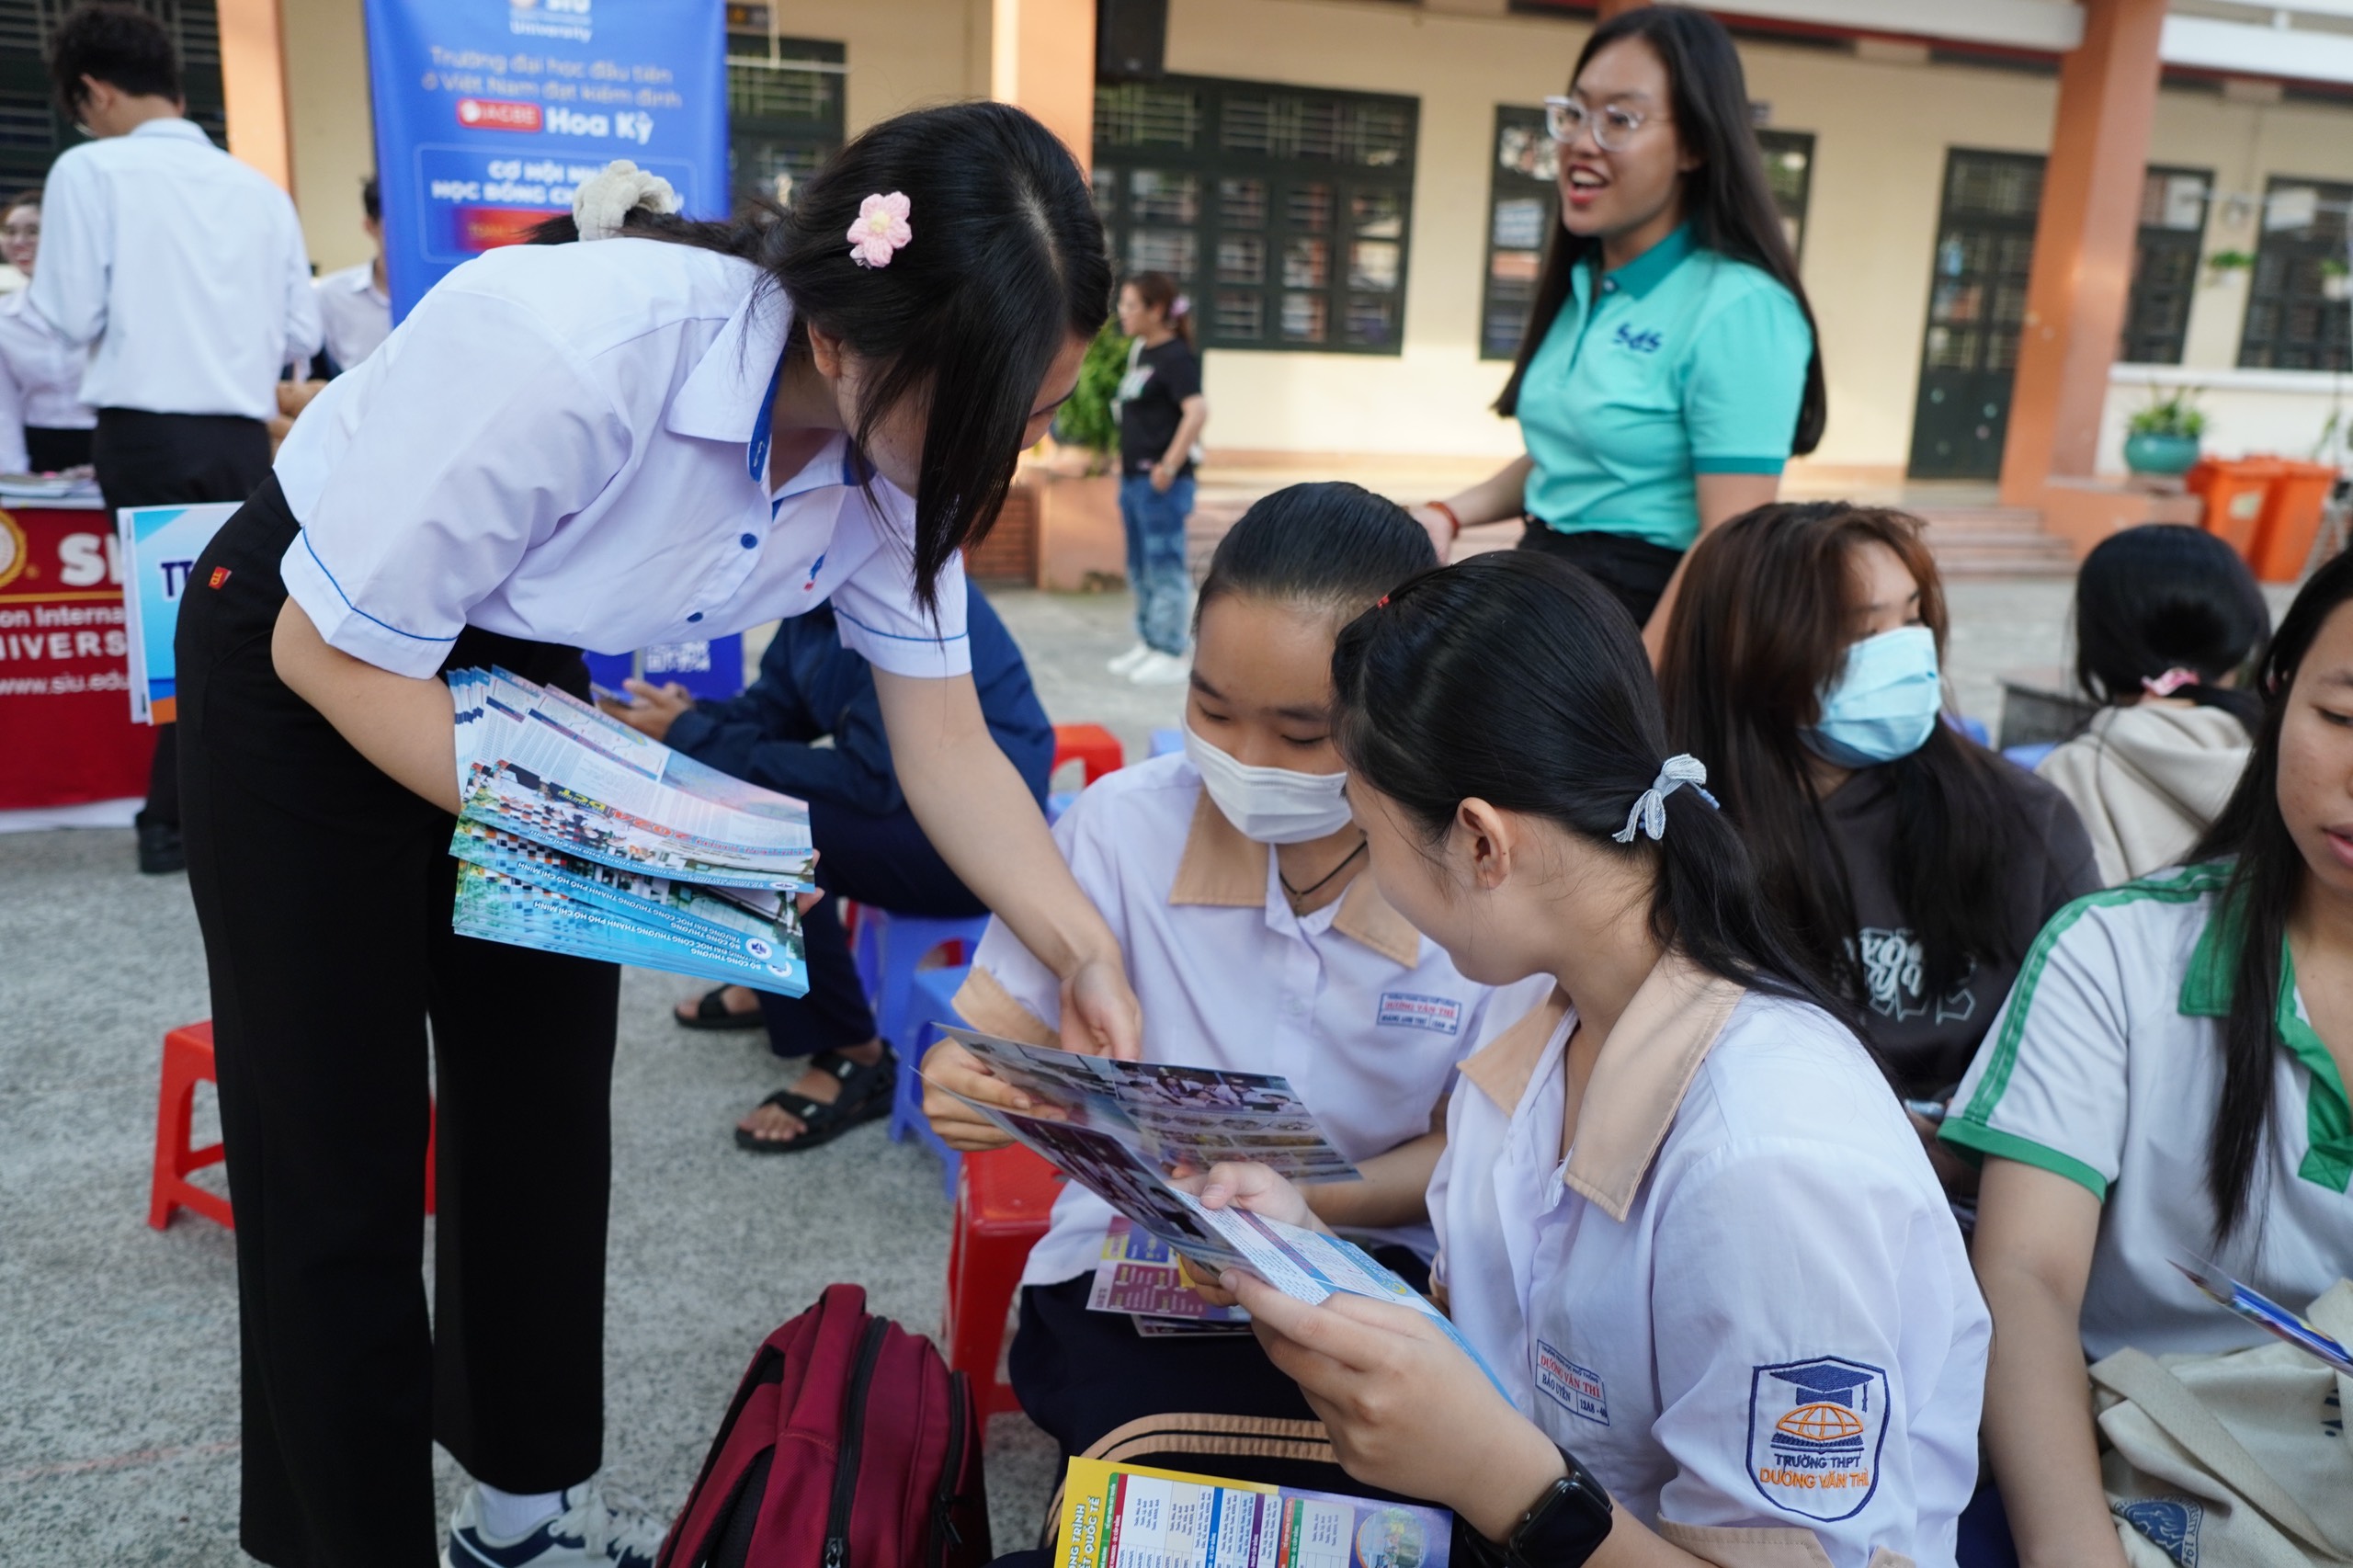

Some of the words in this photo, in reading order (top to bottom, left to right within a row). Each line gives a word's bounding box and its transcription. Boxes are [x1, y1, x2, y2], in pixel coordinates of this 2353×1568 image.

[509, 20, 592, 43] University
[545, 107, 609, 138] Hoa
[616, 109, 654, 146] Kỳ
[517, 861, 541, 875] MINH
[533, 900, 558, 913] MINH
[1564, 1372, 1580, 1390] VĂN
[1774, 1453, 1827, 1469] TRƯỜNG
[1831, 1456, 1860, 1469] THPT
[1819, 1470, 1848, 1489] VĂN
[1086, 1495, 1100, 1513] TẾ
[1070, 1503, 1086, 1543] TRÌNH
[1080, 1515, 1097, 1553] QUỐC
